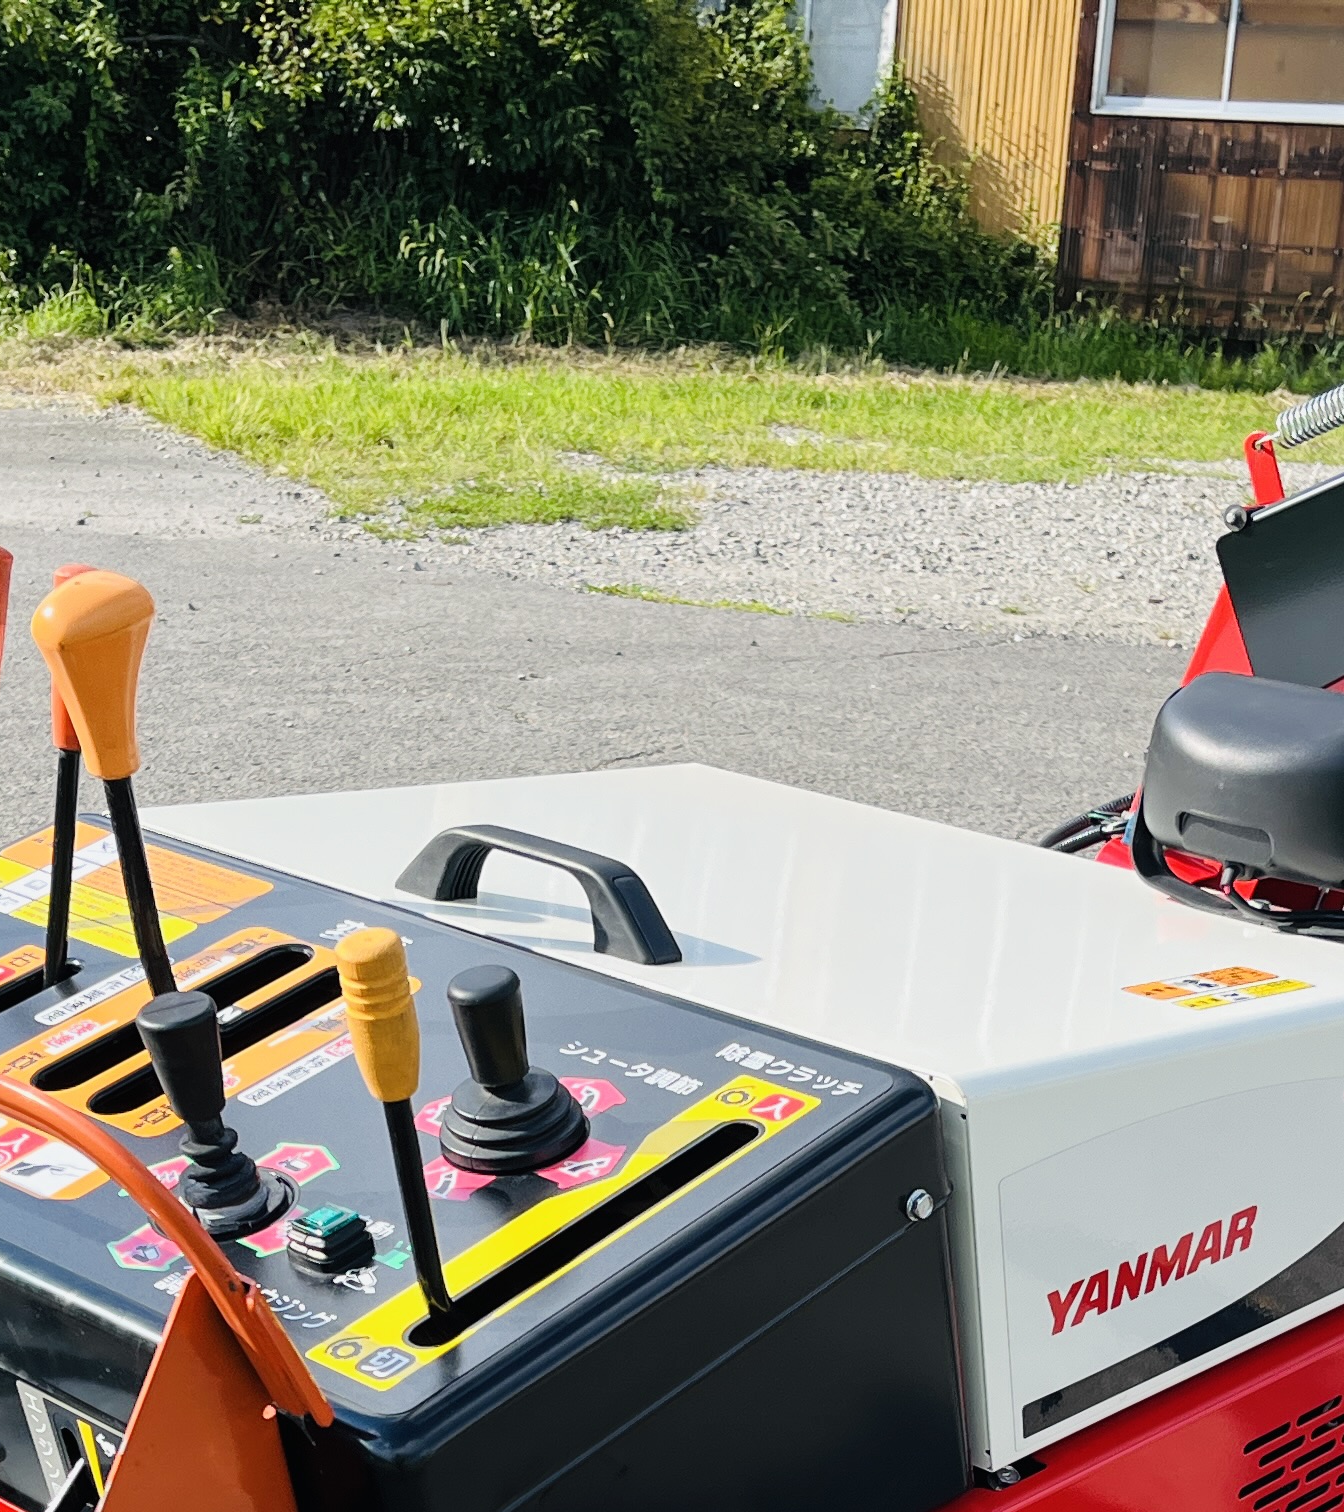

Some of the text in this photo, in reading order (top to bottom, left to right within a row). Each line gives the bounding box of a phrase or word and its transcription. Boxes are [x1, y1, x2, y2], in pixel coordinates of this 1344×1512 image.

[714, 1043, 865, 1096] 除雪クラッチ
[752, 1097, 790, 1120] 入
[1047, 1205, 1258, 1336] YANMAR
[256, 1283, 337, 1329] ウジング
[361, 1349, 411, 1378] 切
[24, 1390, 65, 1500] エンジン
